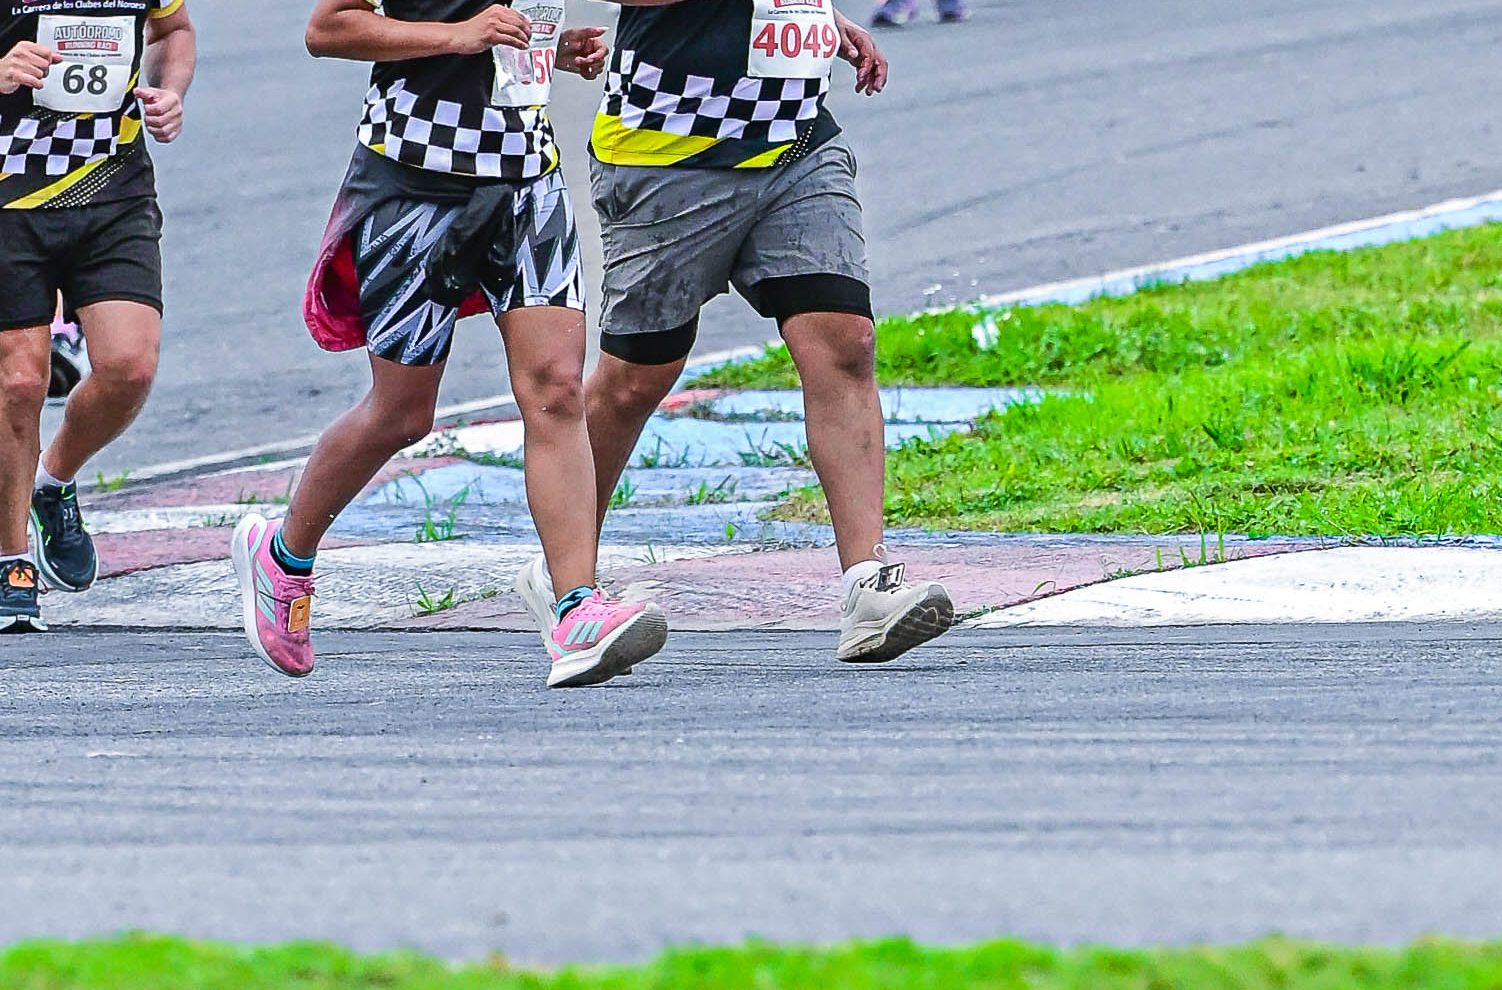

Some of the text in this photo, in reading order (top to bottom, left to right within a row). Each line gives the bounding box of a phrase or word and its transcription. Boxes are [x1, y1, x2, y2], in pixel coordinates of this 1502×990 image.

[12, 7, 21, 15] La
[22, 4, 51, 14] Carrera
[52, 1, 62, 10] de
[63, 0, 73, 9] los
[75, 0, 102, 9] Clubes
[103, 0, 116, 8] del
[54, 21, 123, 40] AUTÓDROMO
[753, 22, 837, 58] 4049
[63, 64, 107, 95] 68
